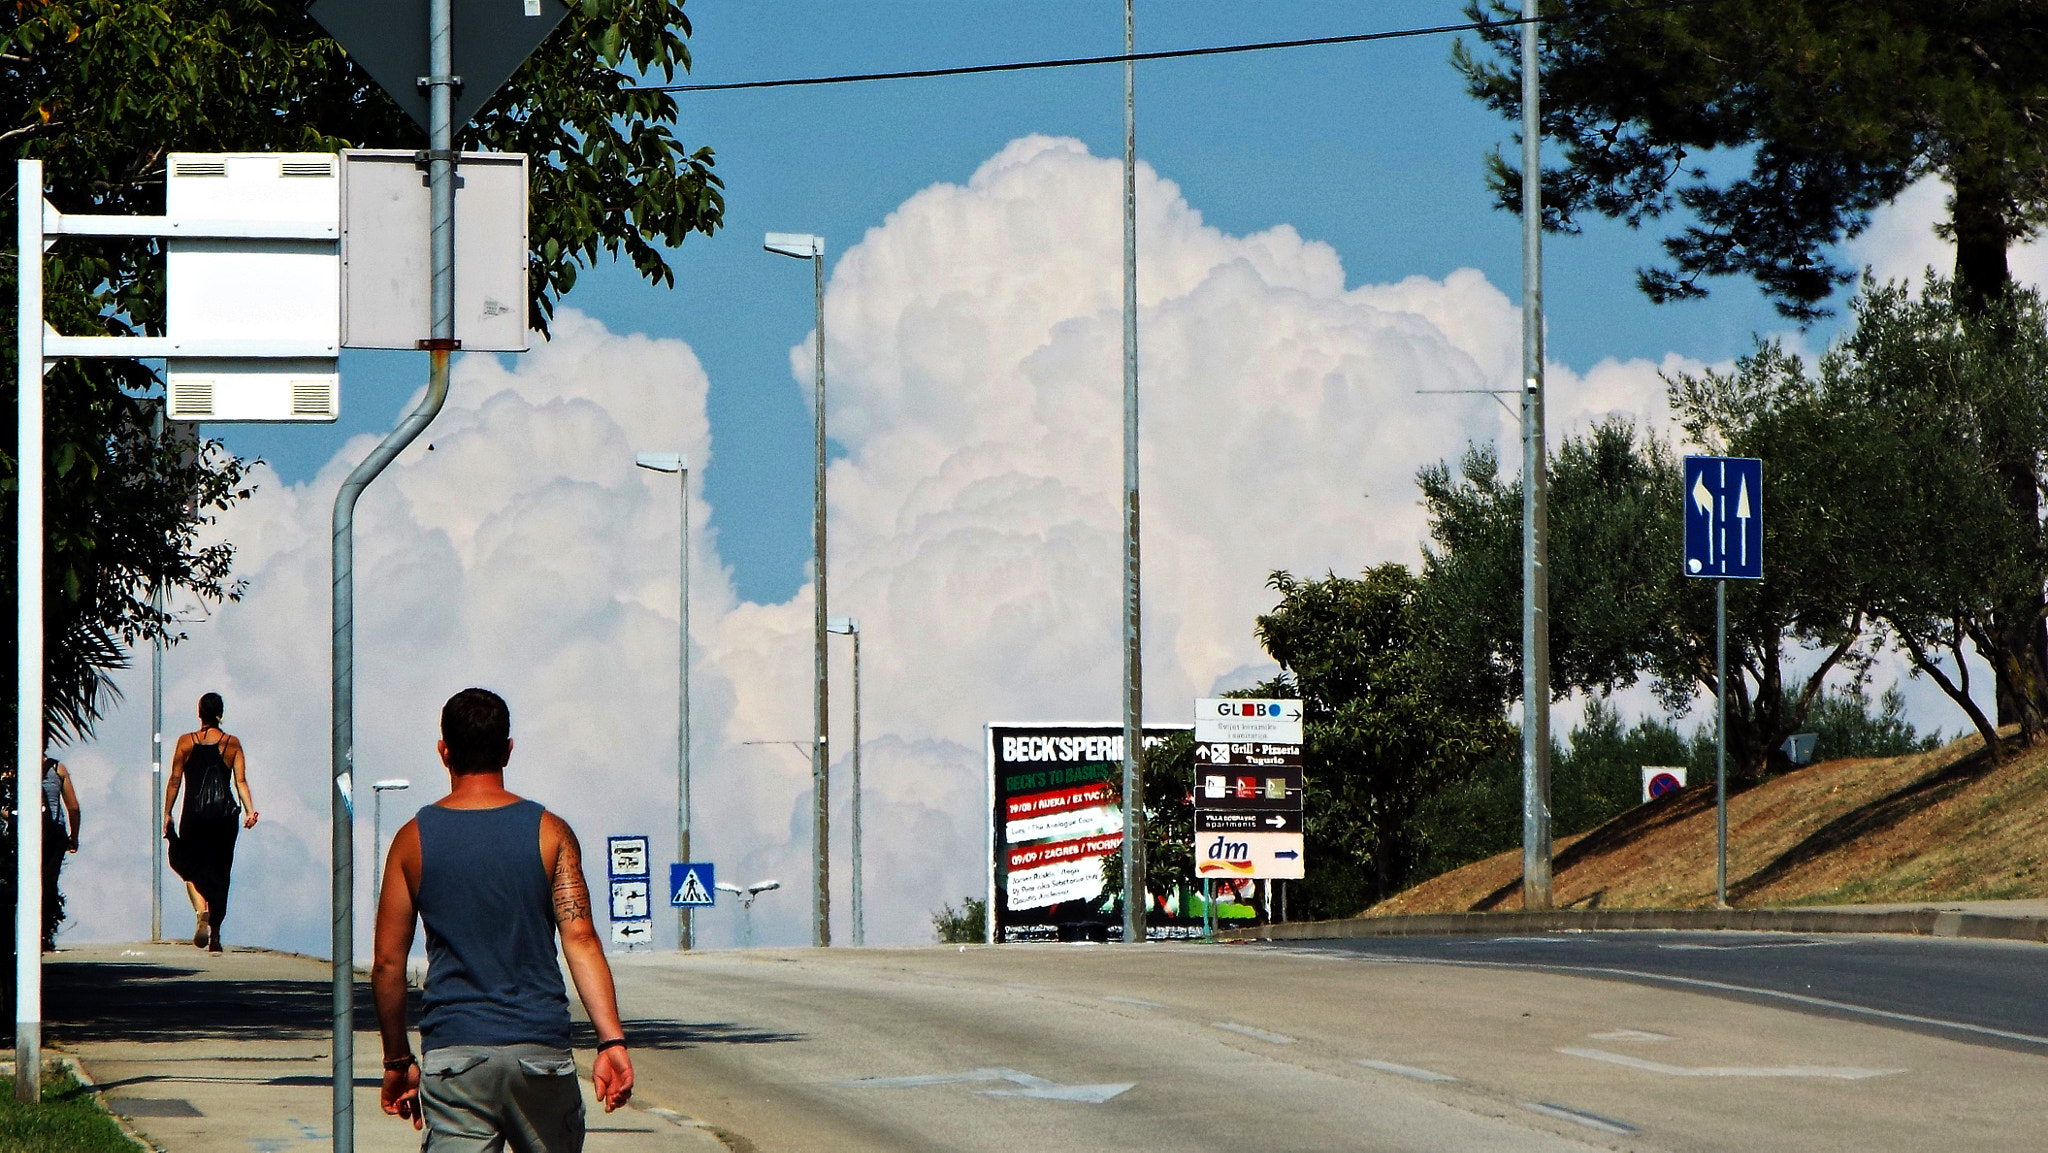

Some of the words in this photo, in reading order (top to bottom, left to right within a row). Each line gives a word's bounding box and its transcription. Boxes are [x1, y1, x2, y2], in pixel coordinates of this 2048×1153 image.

[1231, 743, 1254, 755] Grill
[1262, 744, 1300, 756] Pizzeria
[1246, 756, 1285, 766] Tugurio
[1006, 772, 1046, 792] BECK'S
[1048, 769, 1064, 785] TO
[1011, 853, 1037, 866] 09/09
[1044, 845, 1080, 860] ZAGREB
[1208, 835, 1249, 860] dm
